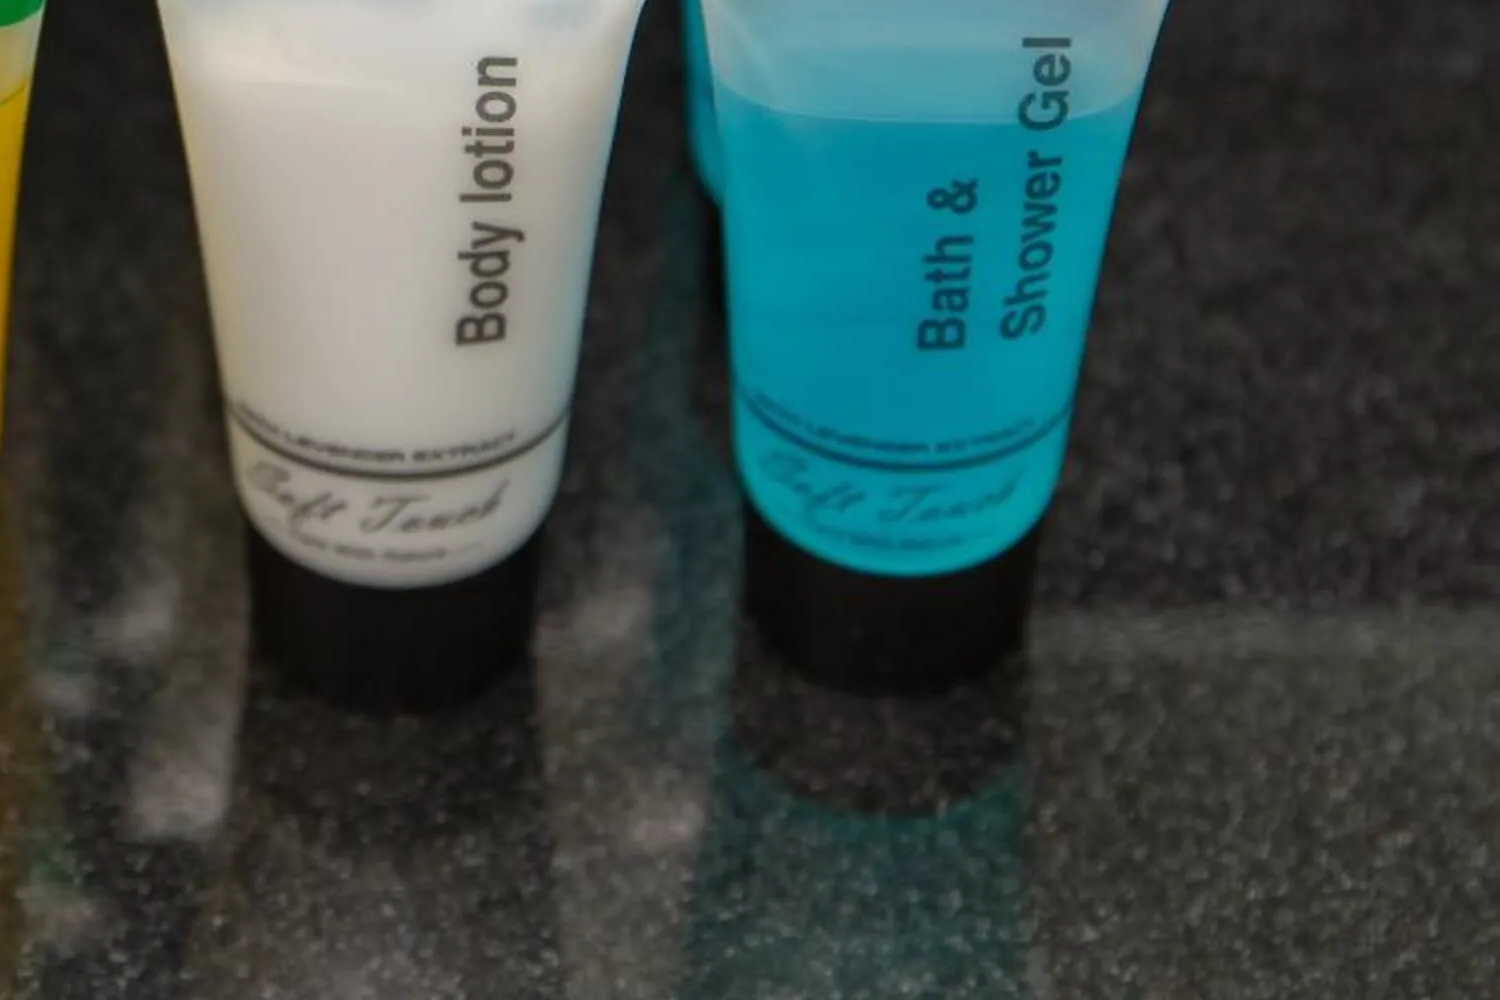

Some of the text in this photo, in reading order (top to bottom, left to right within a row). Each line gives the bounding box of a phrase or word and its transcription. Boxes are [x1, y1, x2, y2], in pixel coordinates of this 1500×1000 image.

[455, 56, 526, 347] Body lotion
[917, 178, 979, 351] Bath &
[1000, 37, 1072, 340] Shower Gel
